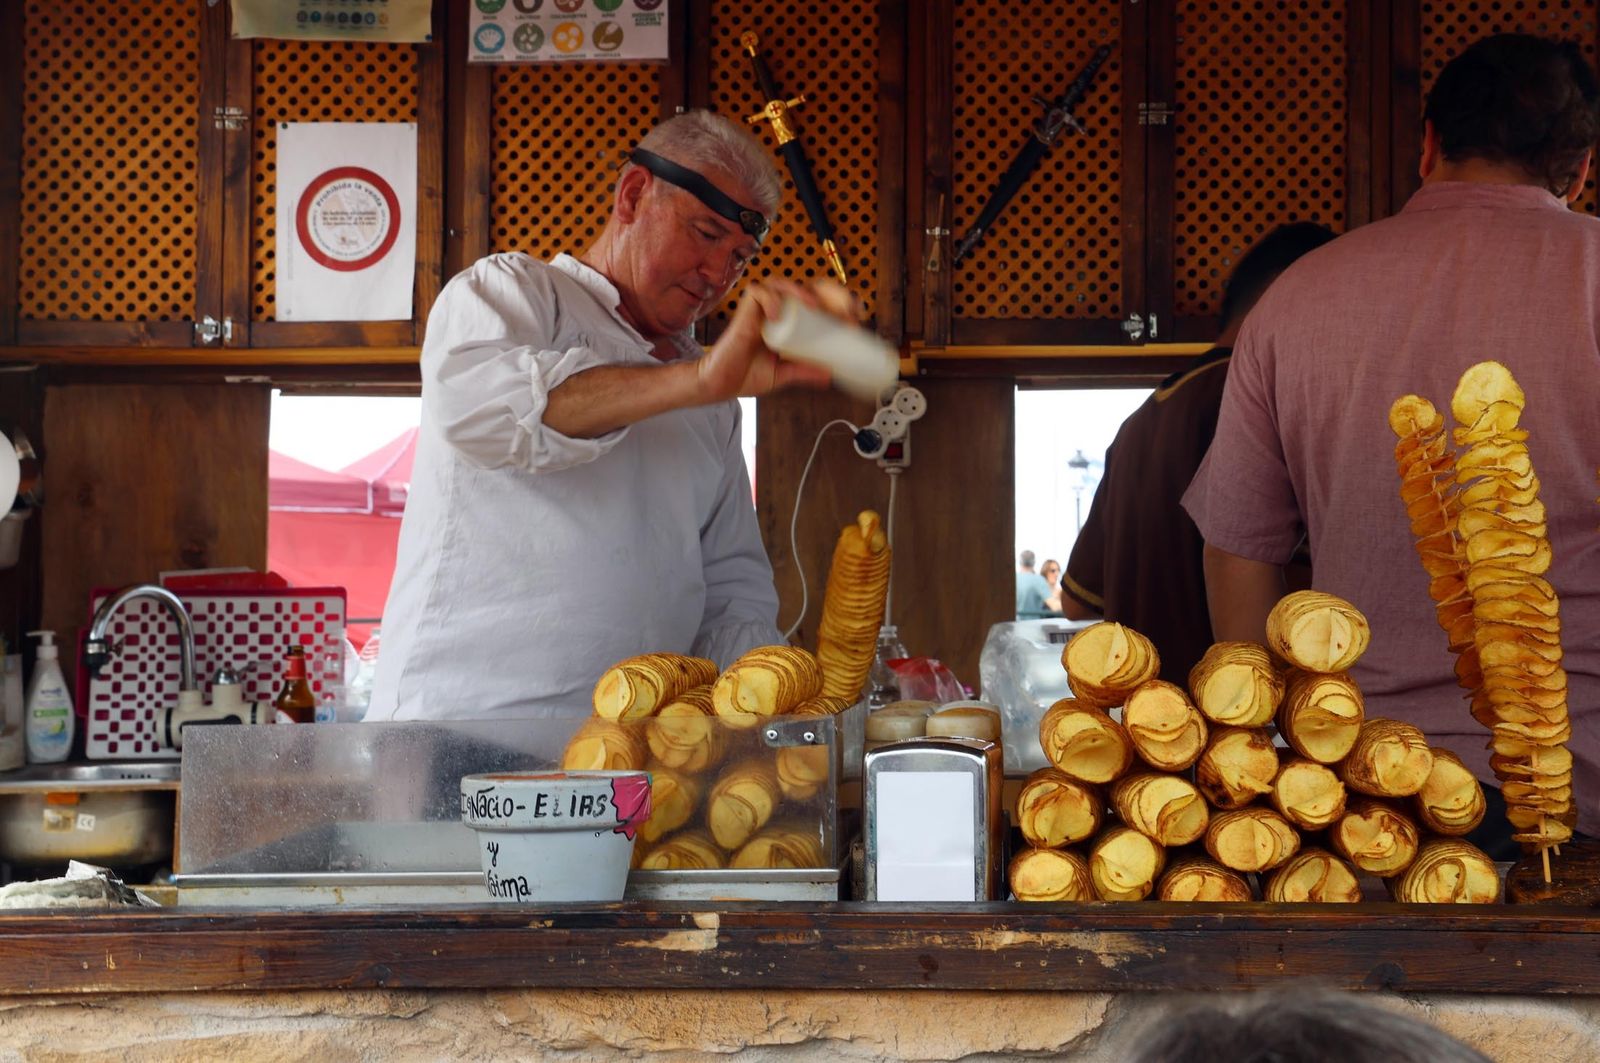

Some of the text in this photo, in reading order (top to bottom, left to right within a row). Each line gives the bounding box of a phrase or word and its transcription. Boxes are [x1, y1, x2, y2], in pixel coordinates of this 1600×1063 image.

[315, 182, 382, 207] Prohibida la venta
